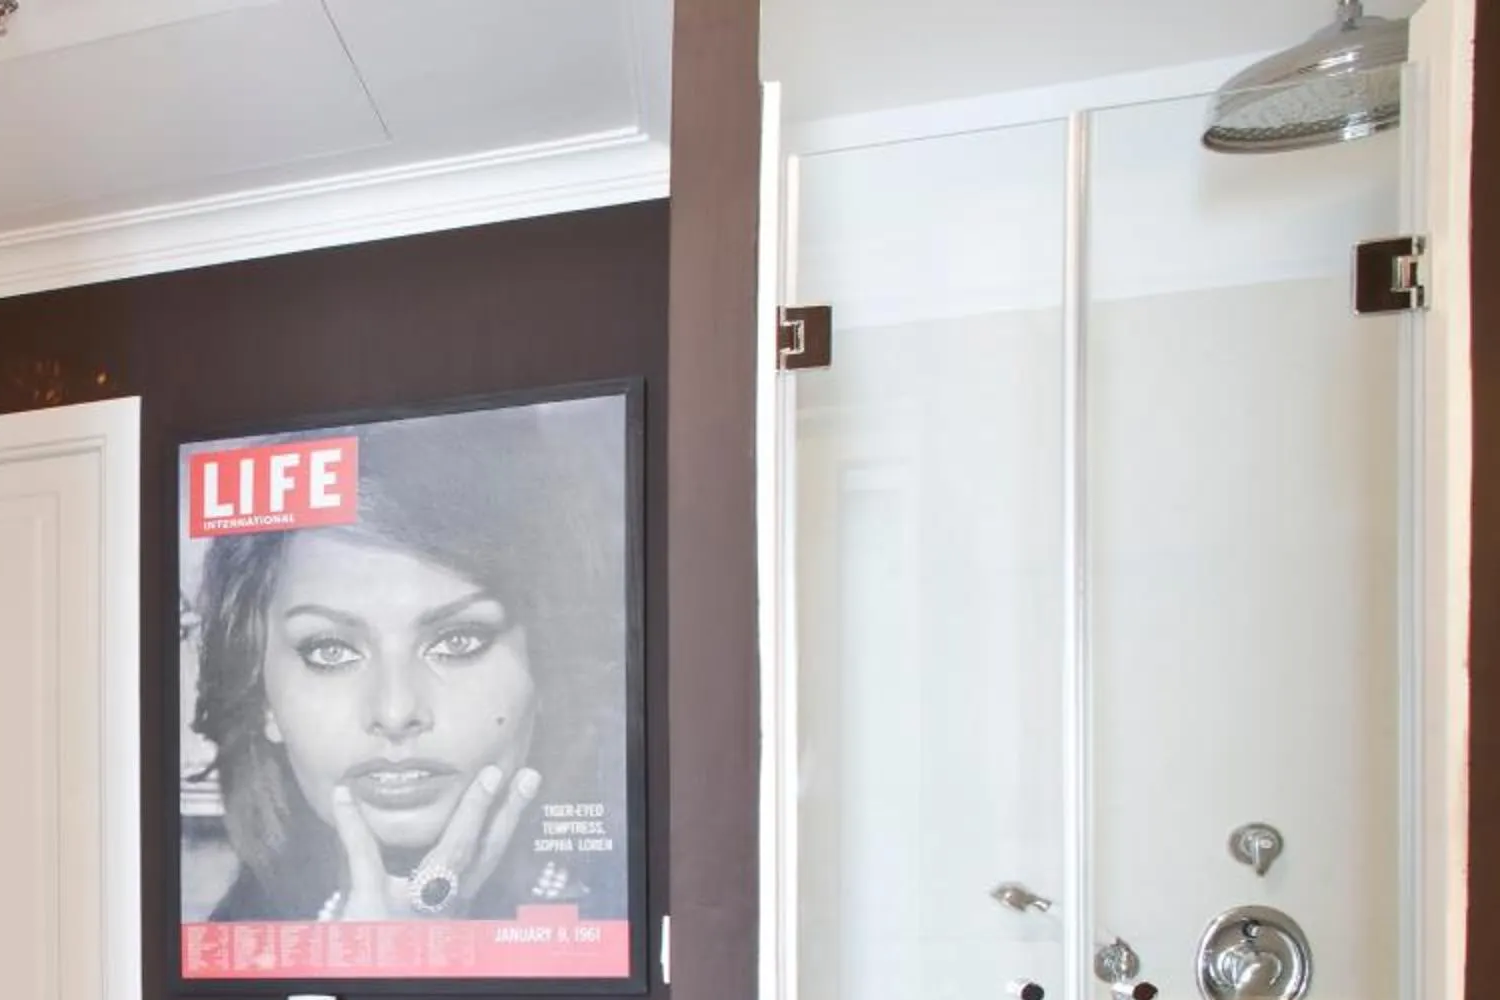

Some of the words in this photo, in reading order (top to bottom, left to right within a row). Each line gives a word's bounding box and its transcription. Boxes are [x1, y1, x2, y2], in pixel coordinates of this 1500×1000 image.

[204, 449, 341, 518] LIFE
[204, 514, 295, 529] INTERNATIONAL
[543, 804, 605, 817] TIGER-EYED
[534, 838, 574, 852] SOPHIA
[578, 838, 613, 851] LOREN
[495, 926, 551, 943] JANUARY
[575, 926, 601, 943] 1961
